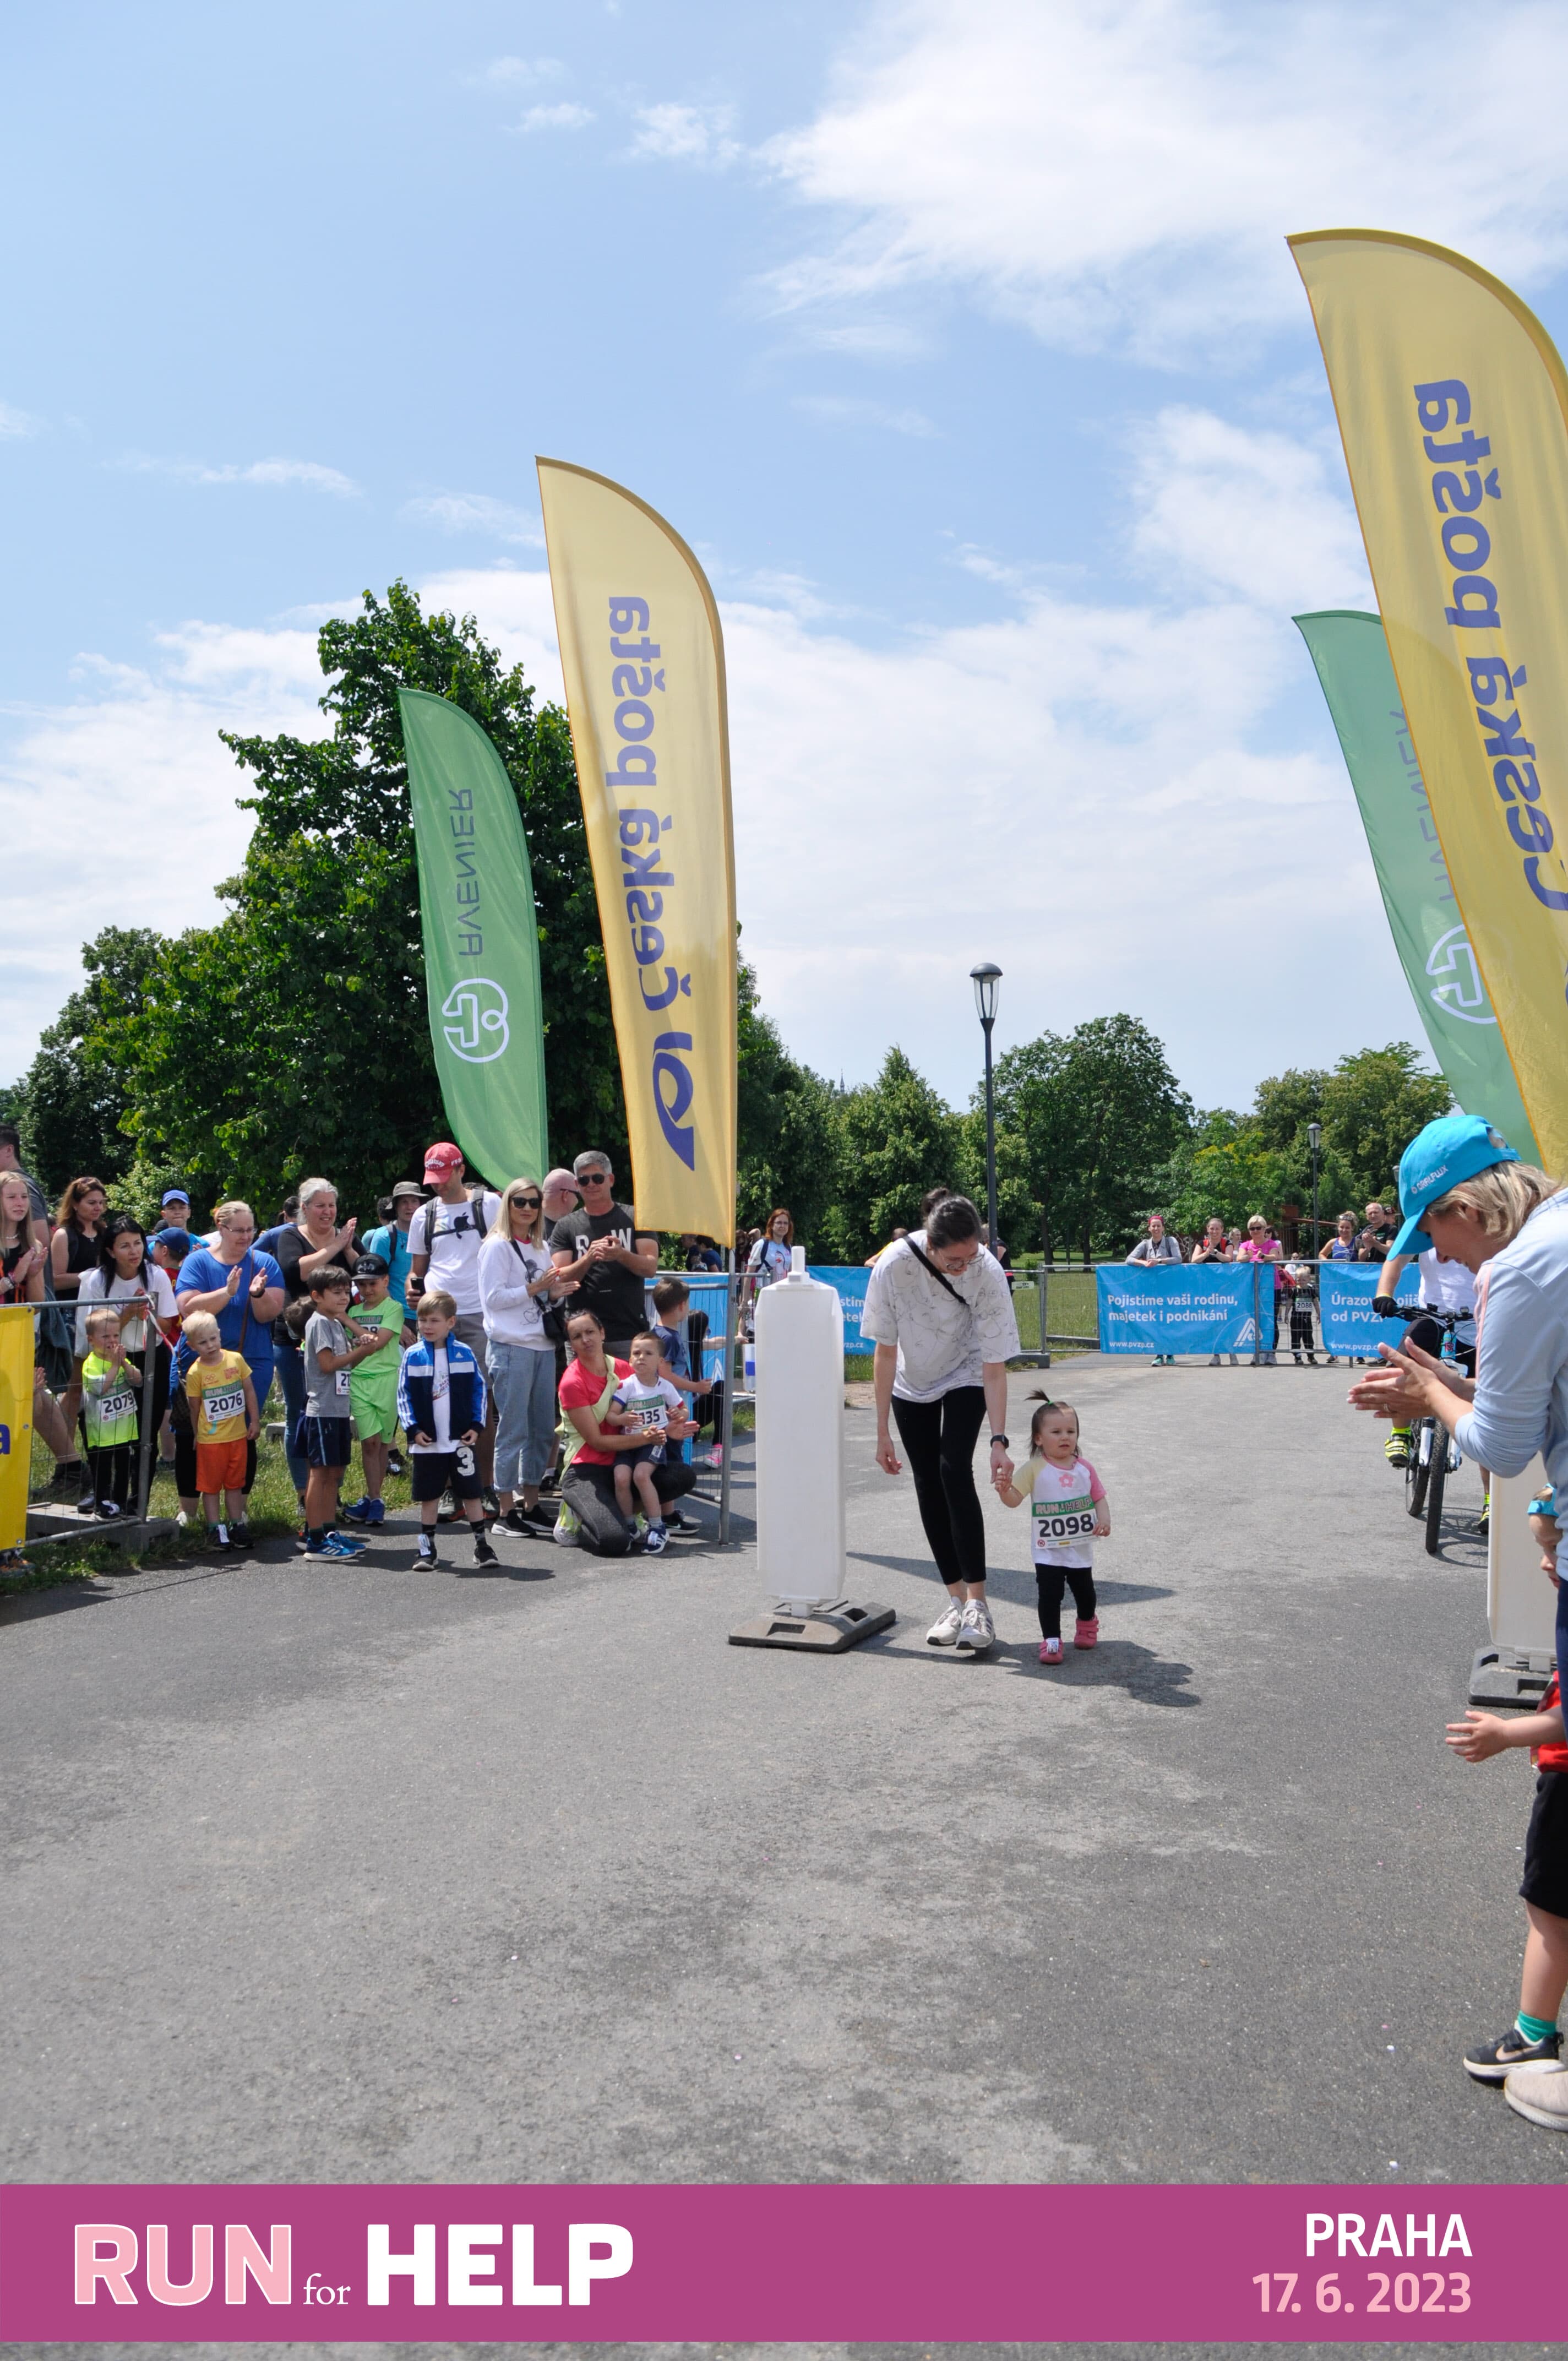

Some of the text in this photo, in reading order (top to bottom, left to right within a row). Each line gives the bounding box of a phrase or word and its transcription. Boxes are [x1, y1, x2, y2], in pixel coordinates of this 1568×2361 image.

[575, 1228, 631, 1260] RW
[1108, 1293, 1238, 1308] Pojistíme vaši rodinu,
[1393, 1293, 1419, 1305] ojiš
[1109, 1309, 1227, 1324] majetek i podnikání
[1331, 1310, 1347, 1322] od
[102, 1392, 134, 1413] 2079
[209, 1392, 242, 1413] 2076
[634, 1409, 660, 1425] 135
[457, 1446, 475, 1476] 3
[1036, 1504, 1059, 1514] RUN
[1066, 1498, 1092, 1511] HELP
[1038, 1514, 1093, 1537] 2098
